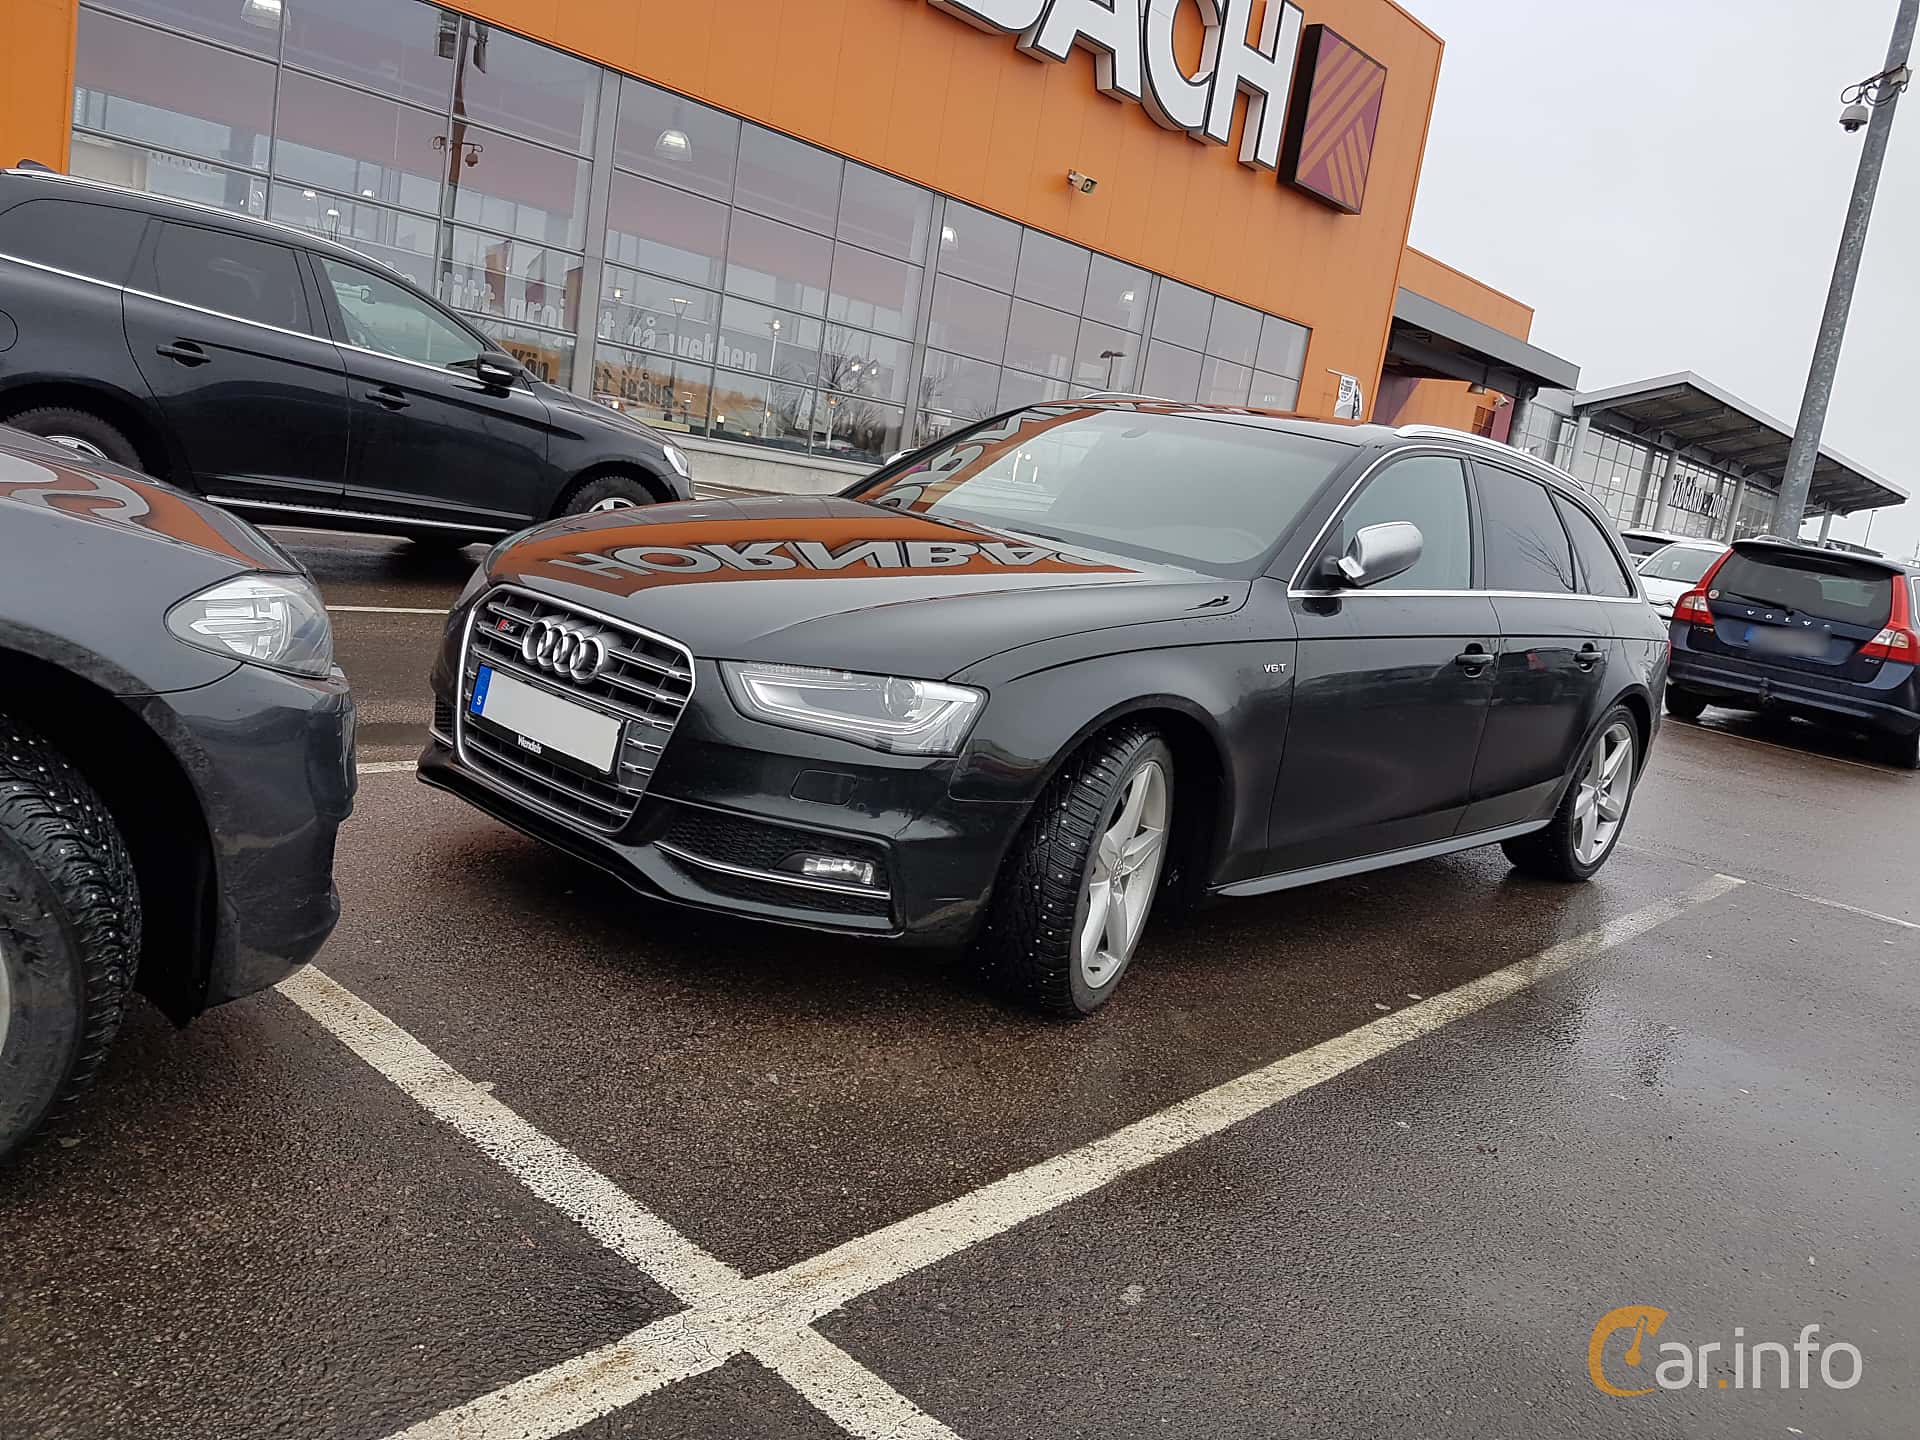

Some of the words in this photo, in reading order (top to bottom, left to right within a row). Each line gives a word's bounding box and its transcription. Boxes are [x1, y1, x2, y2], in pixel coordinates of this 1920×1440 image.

[926, 0, 1304, 171] ACH
[1667, 473, 1704, 514] RÄDGÅRD
[476, 695, 482, 706] S
